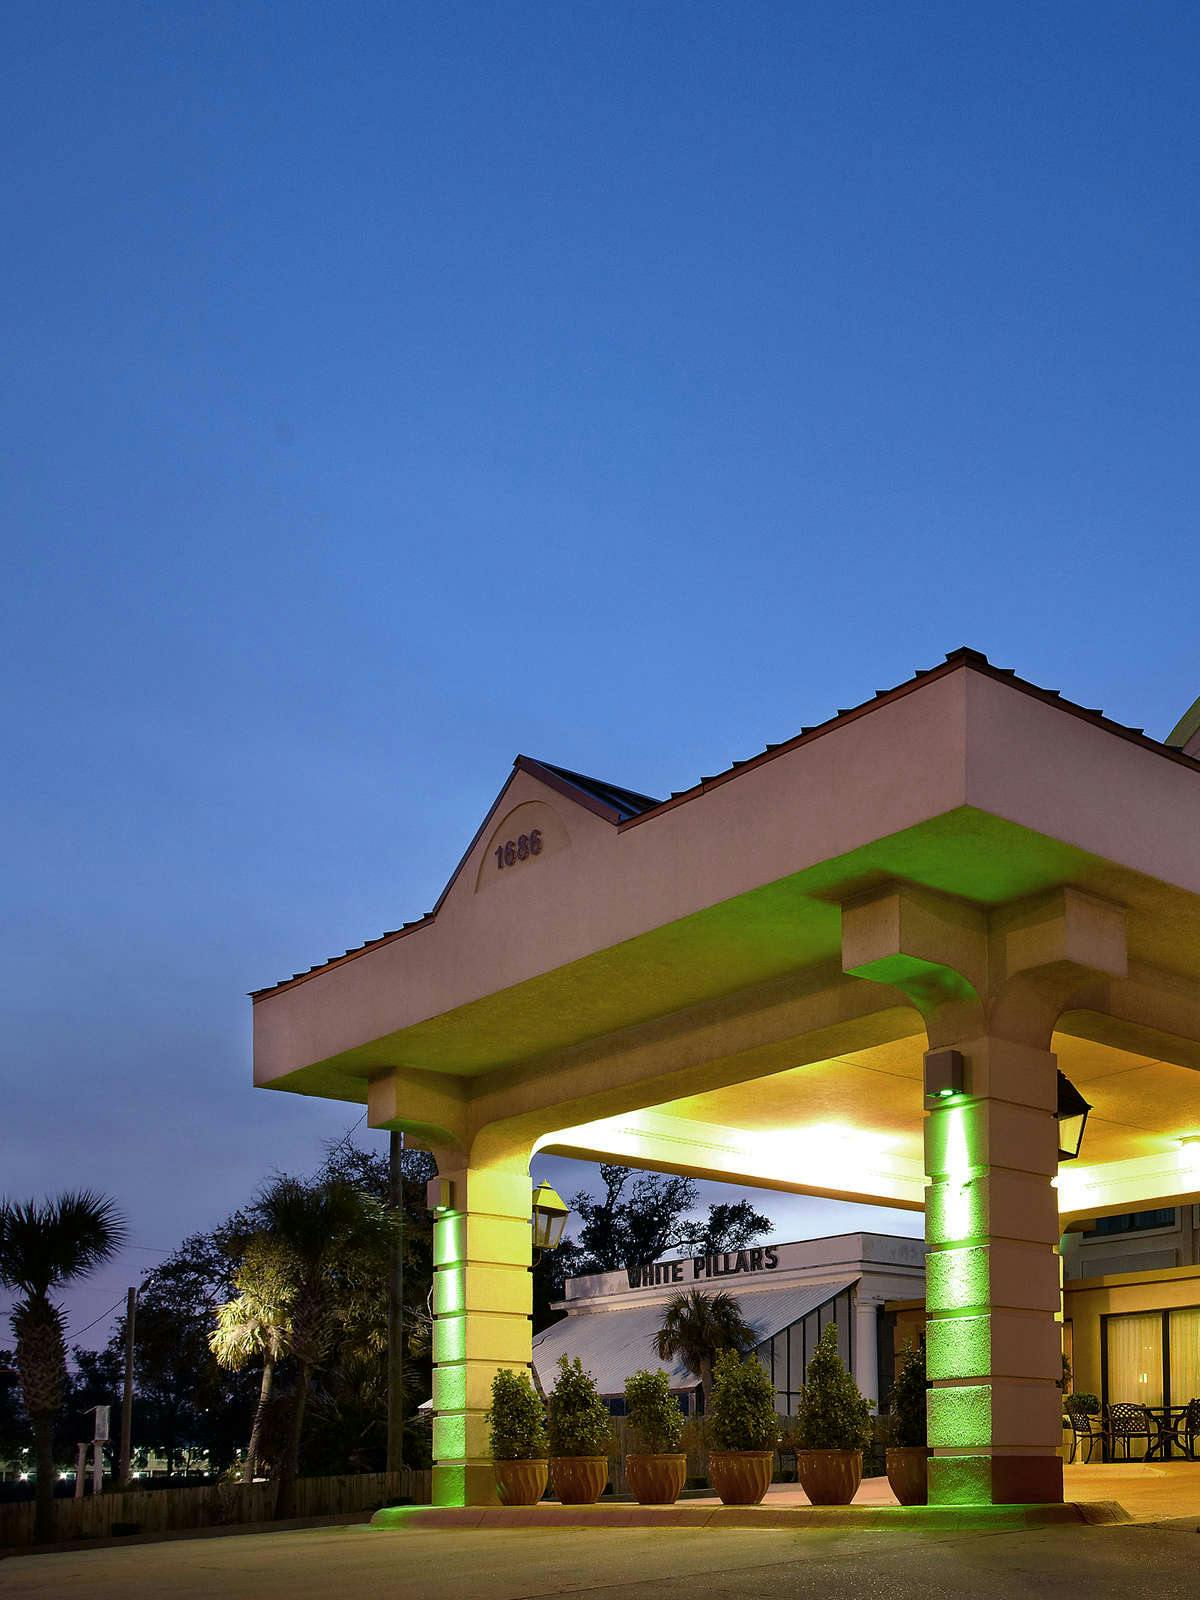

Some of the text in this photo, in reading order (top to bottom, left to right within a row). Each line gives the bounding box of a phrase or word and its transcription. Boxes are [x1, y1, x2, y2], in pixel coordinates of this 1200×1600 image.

[494, 828, 543, 870] 1686
[627, 1246, 778, 1288] WHITE PILLARS
